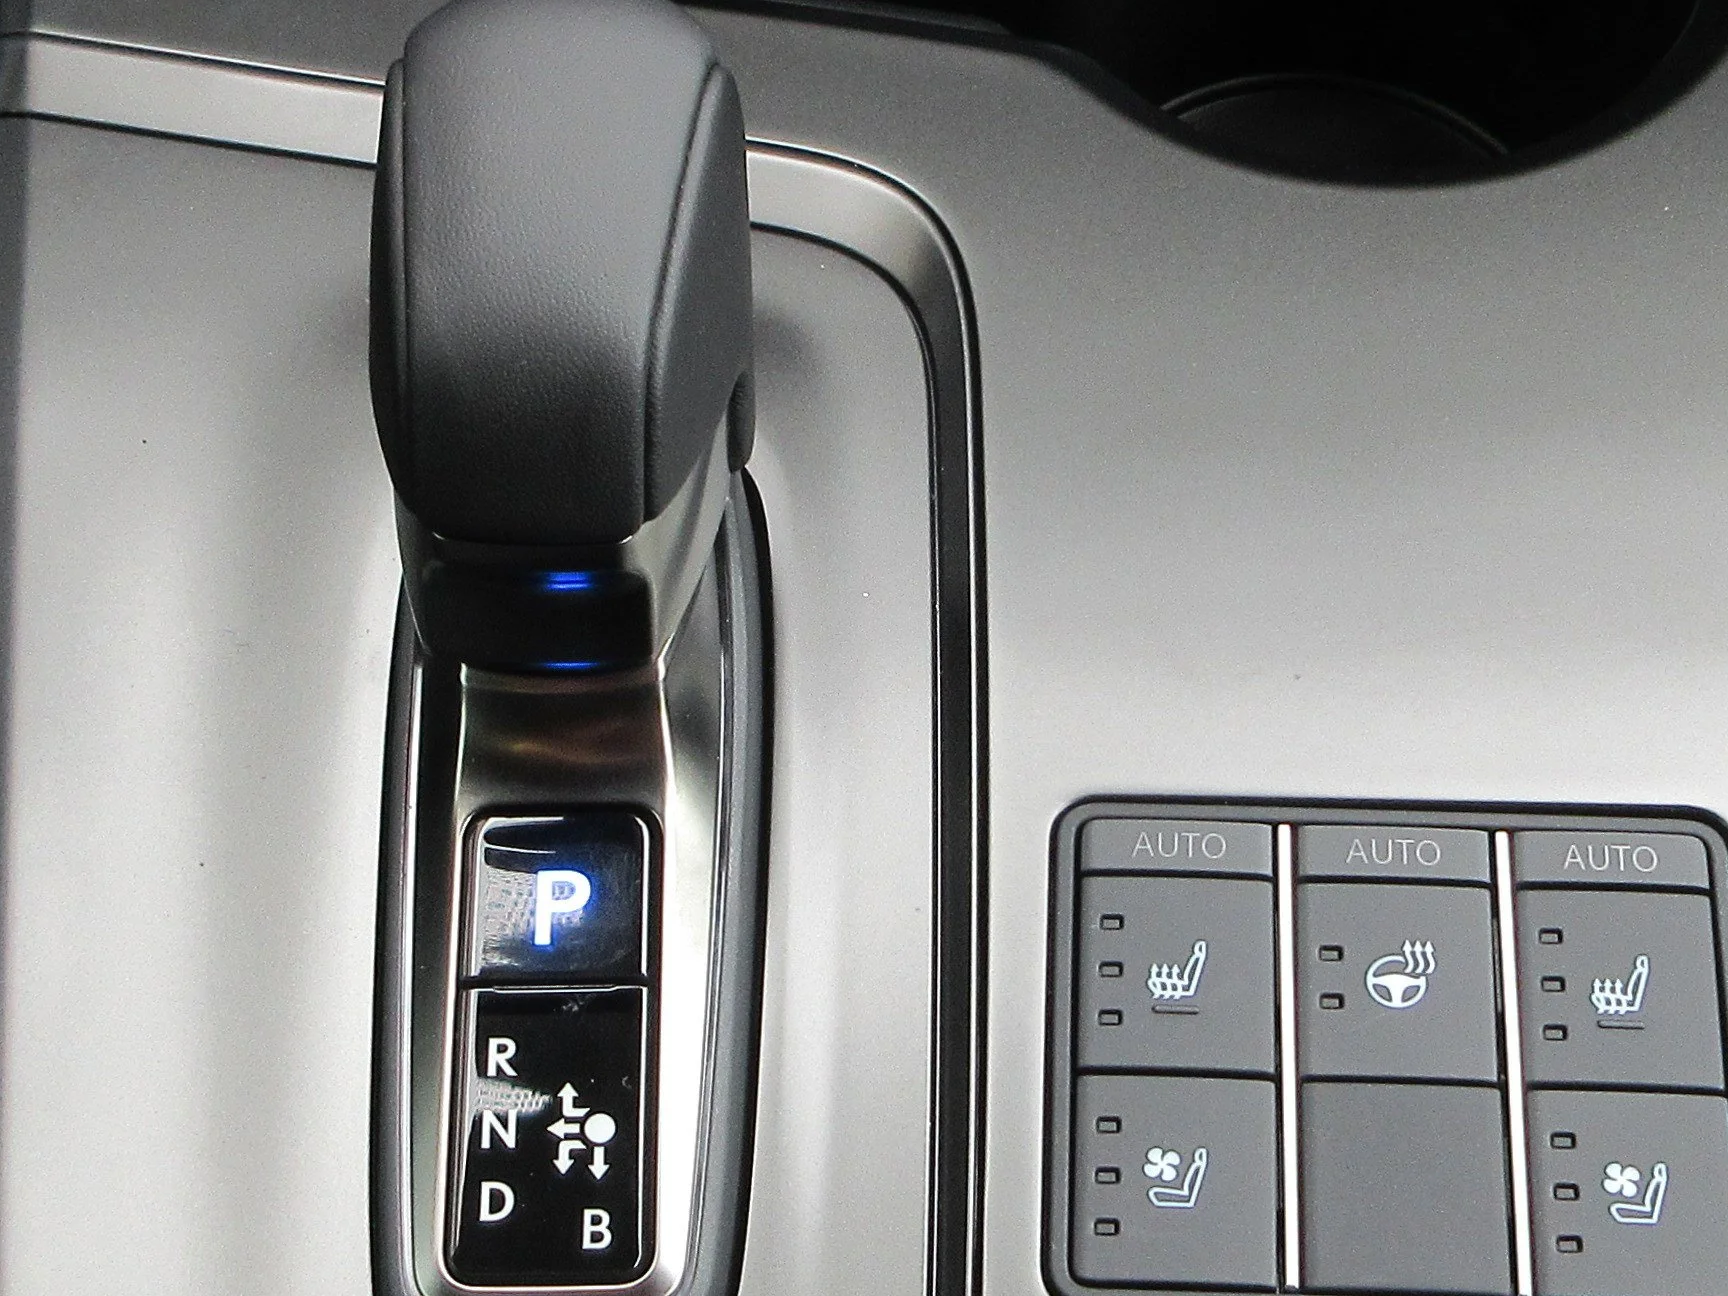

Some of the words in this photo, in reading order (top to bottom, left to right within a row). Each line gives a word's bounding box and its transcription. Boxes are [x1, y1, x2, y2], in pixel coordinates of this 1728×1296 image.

[1131, 831, 1228, 860] AUTO
[1345, 838, 1443, 867] AUTO
[1562, 844, 1659, 873] AUTO
[532, 869, 592, 946] P
[486, 1037, 518, 1077] R
[480, 1109, 517, 1150] N
[479, 1181, 516, 1222] D
[581, 1209, 613, 1250] B
